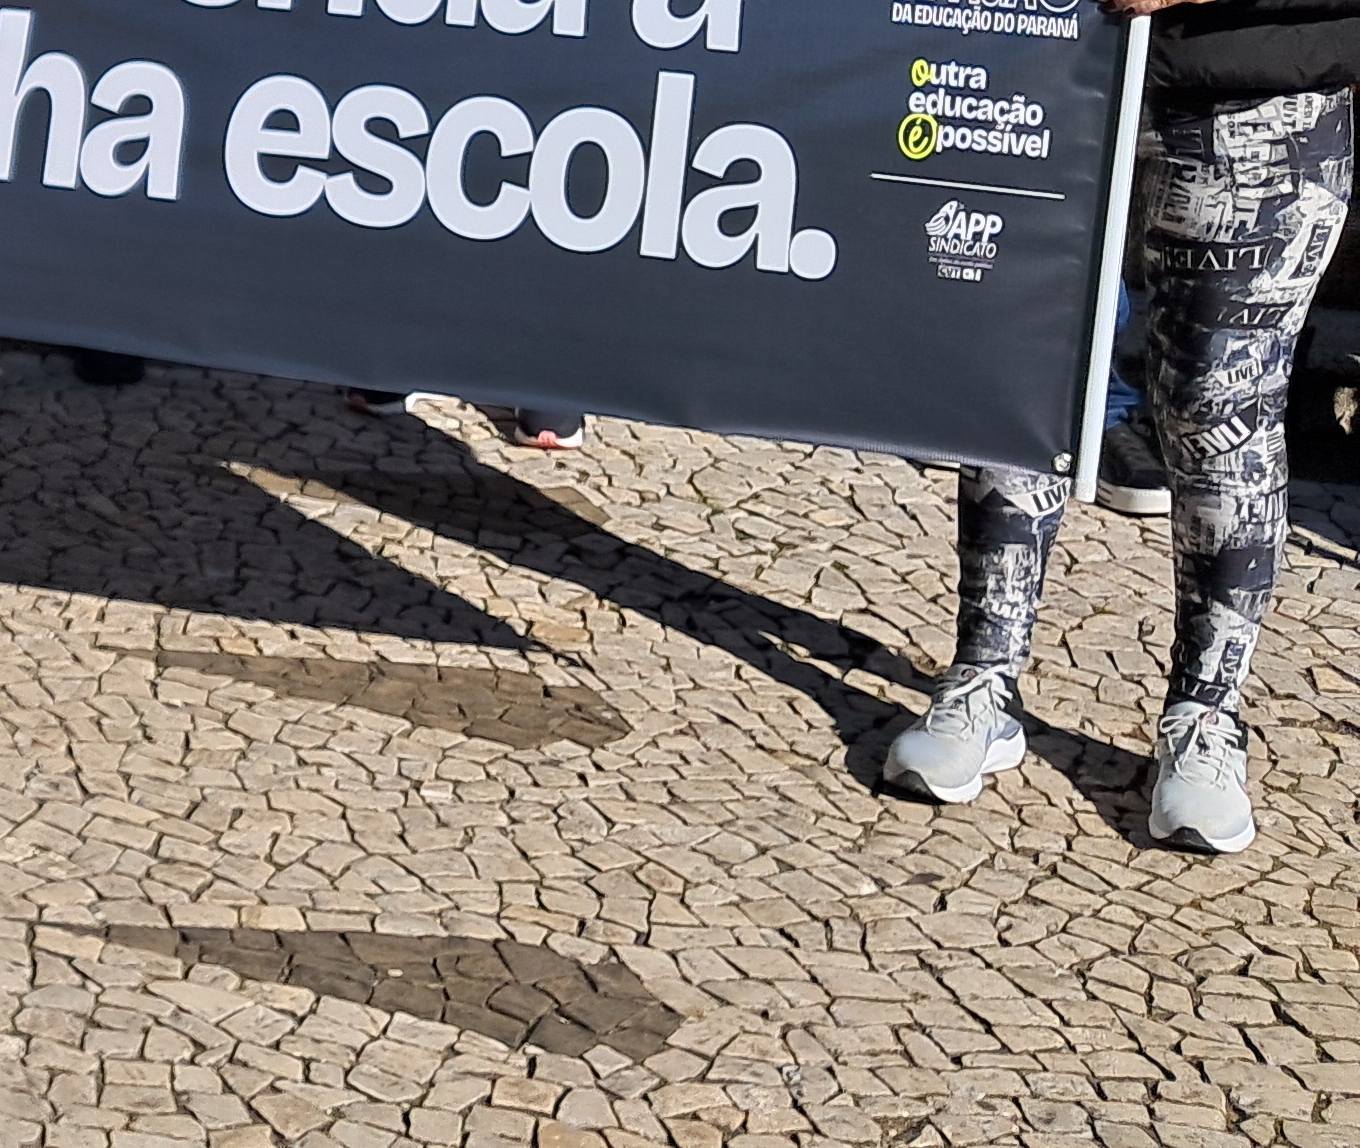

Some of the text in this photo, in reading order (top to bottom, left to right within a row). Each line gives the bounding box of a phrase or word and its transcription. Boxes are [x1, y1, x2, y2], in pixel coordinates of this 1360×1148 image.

[892, 2, 1079, 40] DA EDUCAÇÃO DO PARANÁ
[911, 58, 988, 91] outra
[908, 88, 1044, 129] educação
[935, 125, 1051, 159] possível
[223, 68, 838, 281] escola.
[947, 211, 1003, 244] APP
[928, 236, 997, 259] SINDICATO
[1031, 481, 1067, 513] LIV
